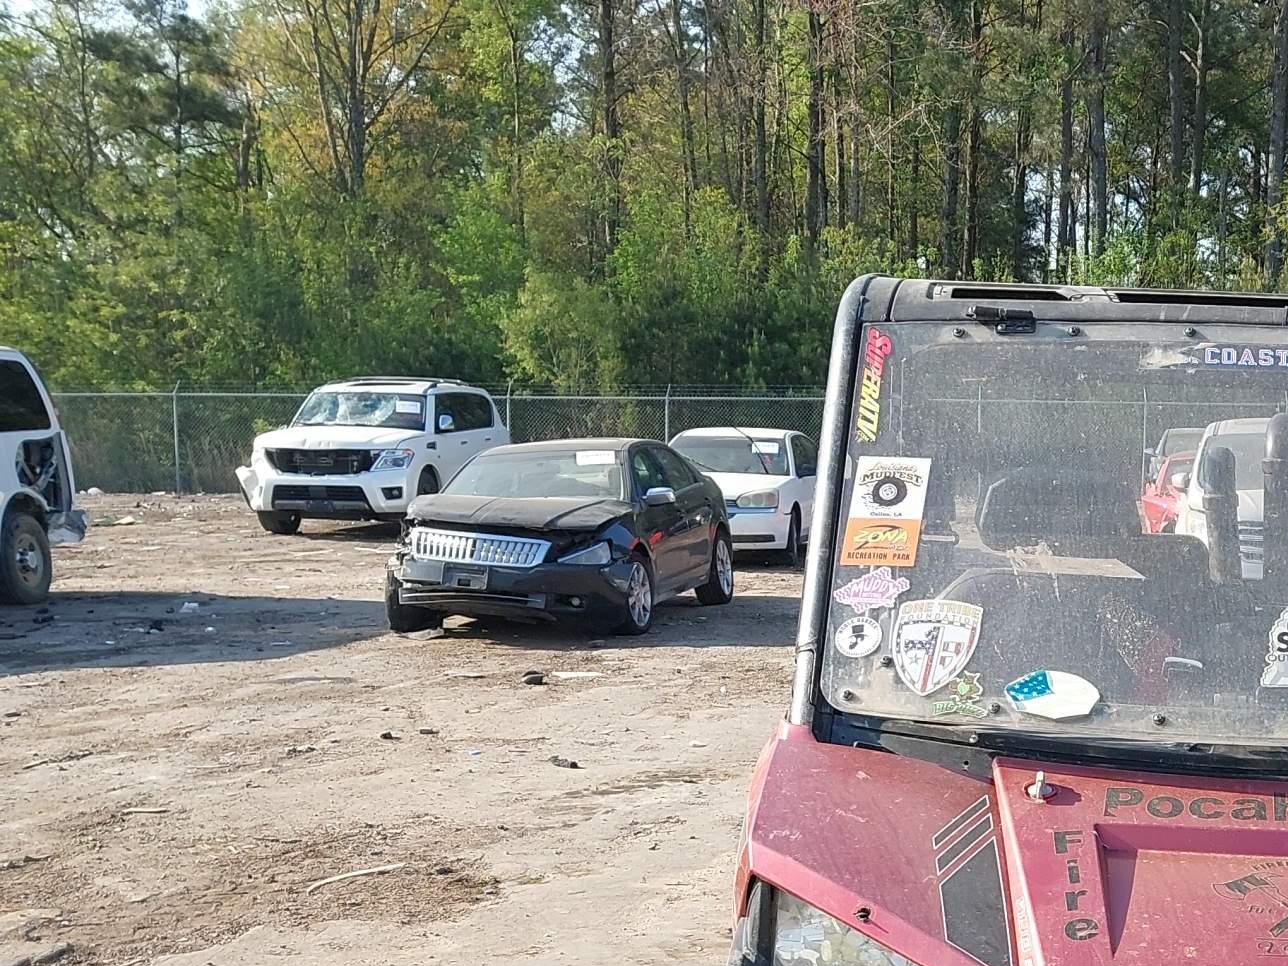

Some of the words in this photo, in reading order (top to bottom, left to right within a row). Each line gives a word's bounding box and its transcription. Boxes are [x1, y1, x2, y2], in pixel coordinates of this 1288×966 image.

[847, 551, 888, 560] RECREATION
[892, 552, 911, 561] PARK
[851, 577, 898, 599] MUDDY
[902, 602, 936, 615] ONE
[1053, 830, 1100, 941] Fire
[1249, 905, 1276, 914] Fire
